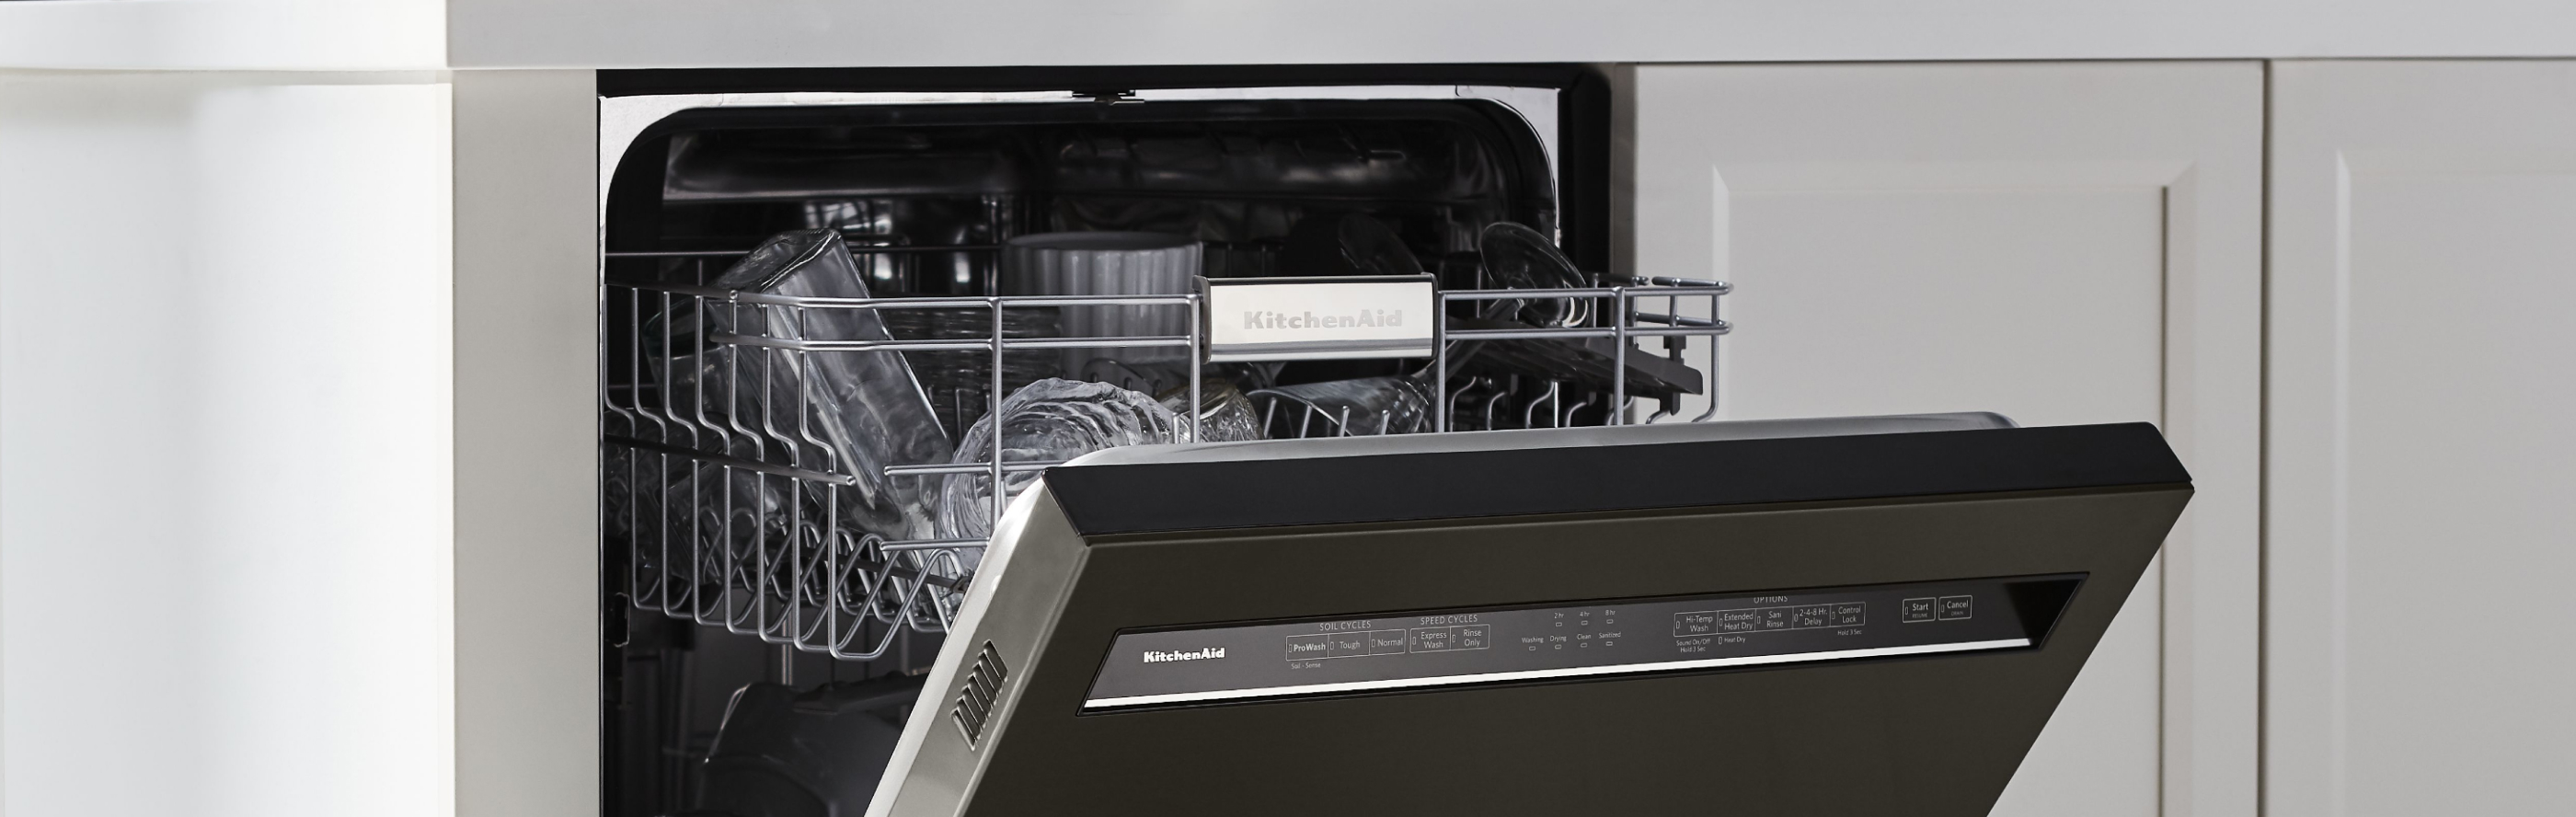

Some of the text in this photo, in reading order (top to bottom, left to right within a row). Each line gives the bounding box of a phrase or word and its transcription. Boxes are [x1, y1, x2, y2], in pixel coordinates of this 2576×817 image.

[1244, 309, 1402, 329] KitchenAid
[1754, 596, 1788, 604] OPTIONS
[1947, 600, 1968, 609] Cancel
[1838, 605, 1861, 614] Control
[1912, 603, 1928, 611] Start
[1725, 613, 1754, 621] Extended
[1768, 611, 1782, 619] Sani
[1800, 608, 1817, 617] 2-4-8
[1420, 614, 1478, 625] SPEED CYCLES
[1686, 615, 1713, 624] Hi-Temp
[1767, 620, 1784, 628] Rinse
[1805, 617, 1822, 626] Delay
[1320, 620, 1371, 631] SOIL CYCLES
[1690, 624, 1709, 633] Wash
[1741, 622, 1753, 630] Dry
[1421, 631, 1447, 640] Express
[1339, 640, 1360, 650] Tough
[1378, 637, 1403, 647] Normal
[1424, 640, 1443, 649] Wash
[1464, 638, 1481, 647] Only
[1294, 643, 1326, 652] ProWash
[1144, 647, 1225, 663] KitchenAid
